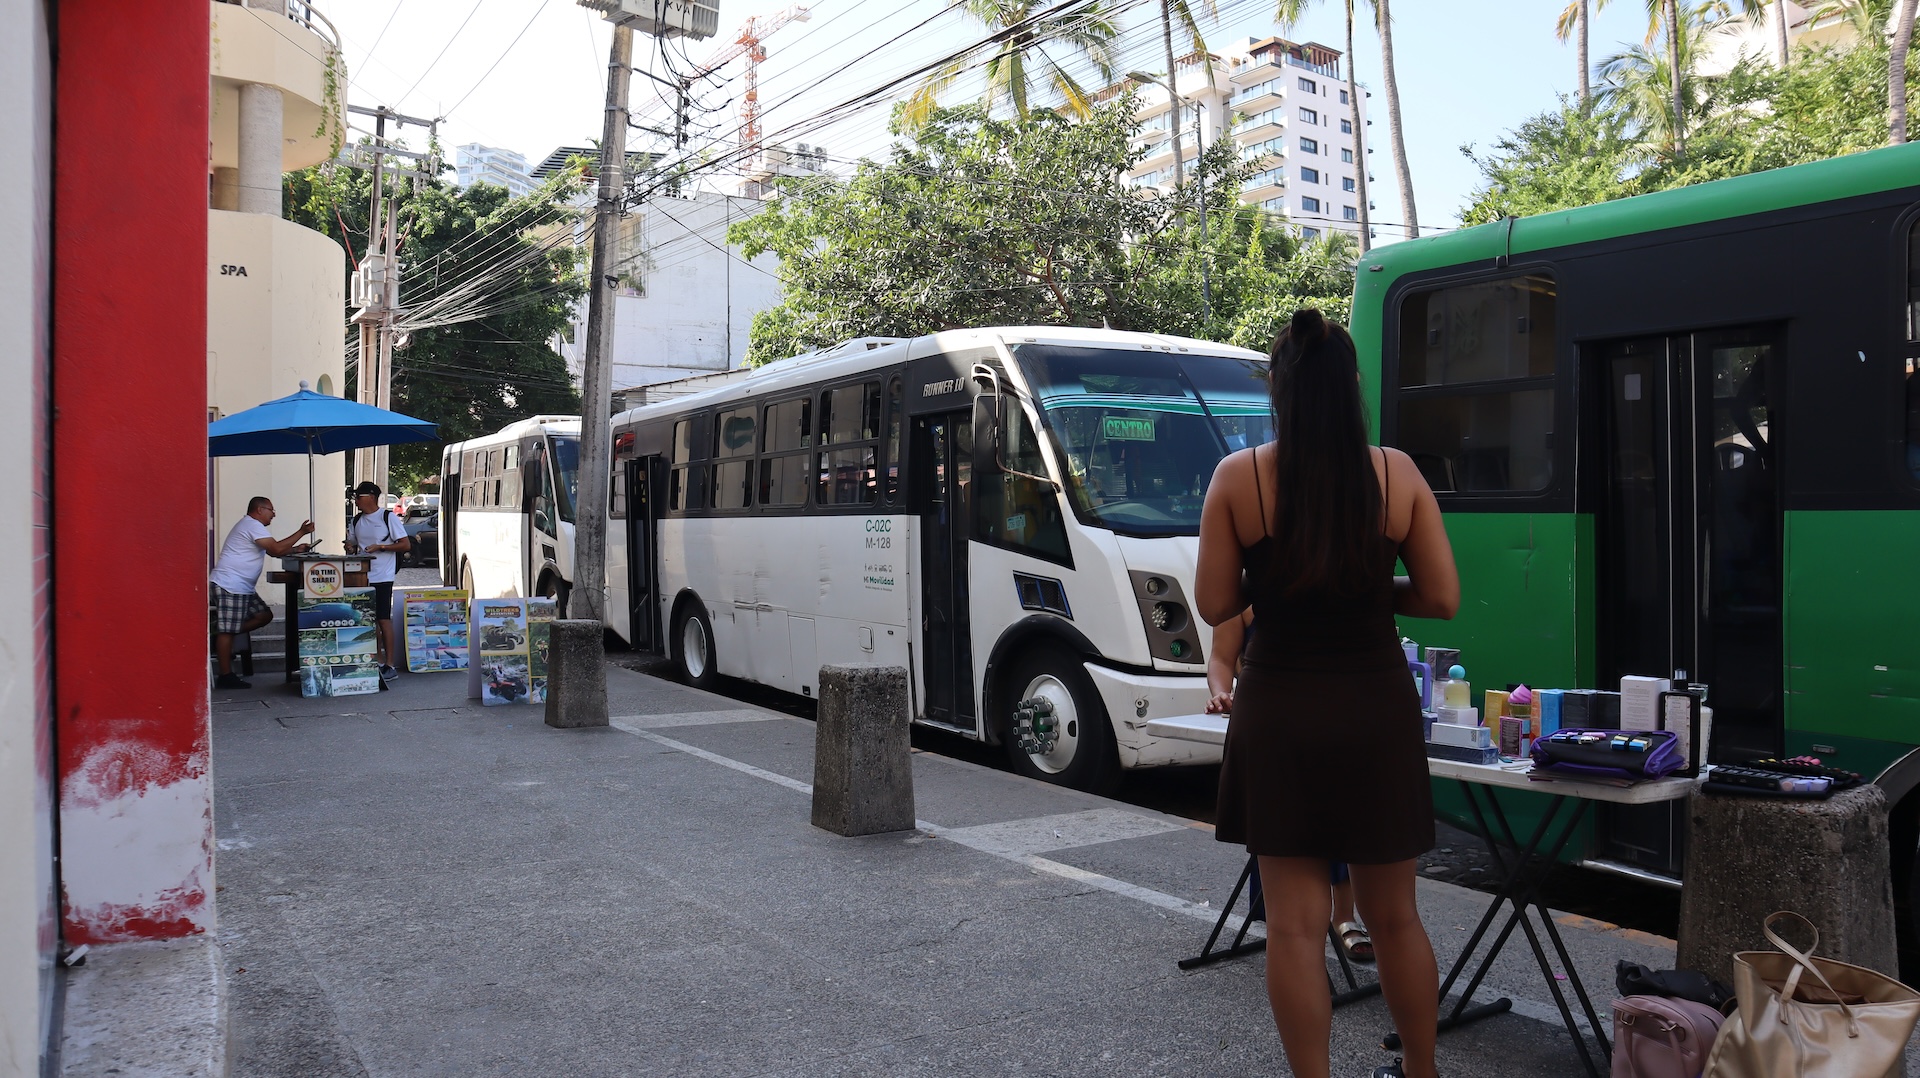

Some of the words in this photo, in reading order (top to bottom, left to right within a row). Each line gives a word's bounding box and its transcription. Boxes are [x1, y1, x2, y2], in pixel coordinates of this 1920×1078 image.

[220, 264, 247, 277] SPA
[922, 379, 954, 397] RUNNER
[1106, 420, 1151, 438] CENTRO
[865, 519, 891, 532] C-02C
[865, 537, 891, 549] M-128
[869, 576, 894, 586] Movilidad
